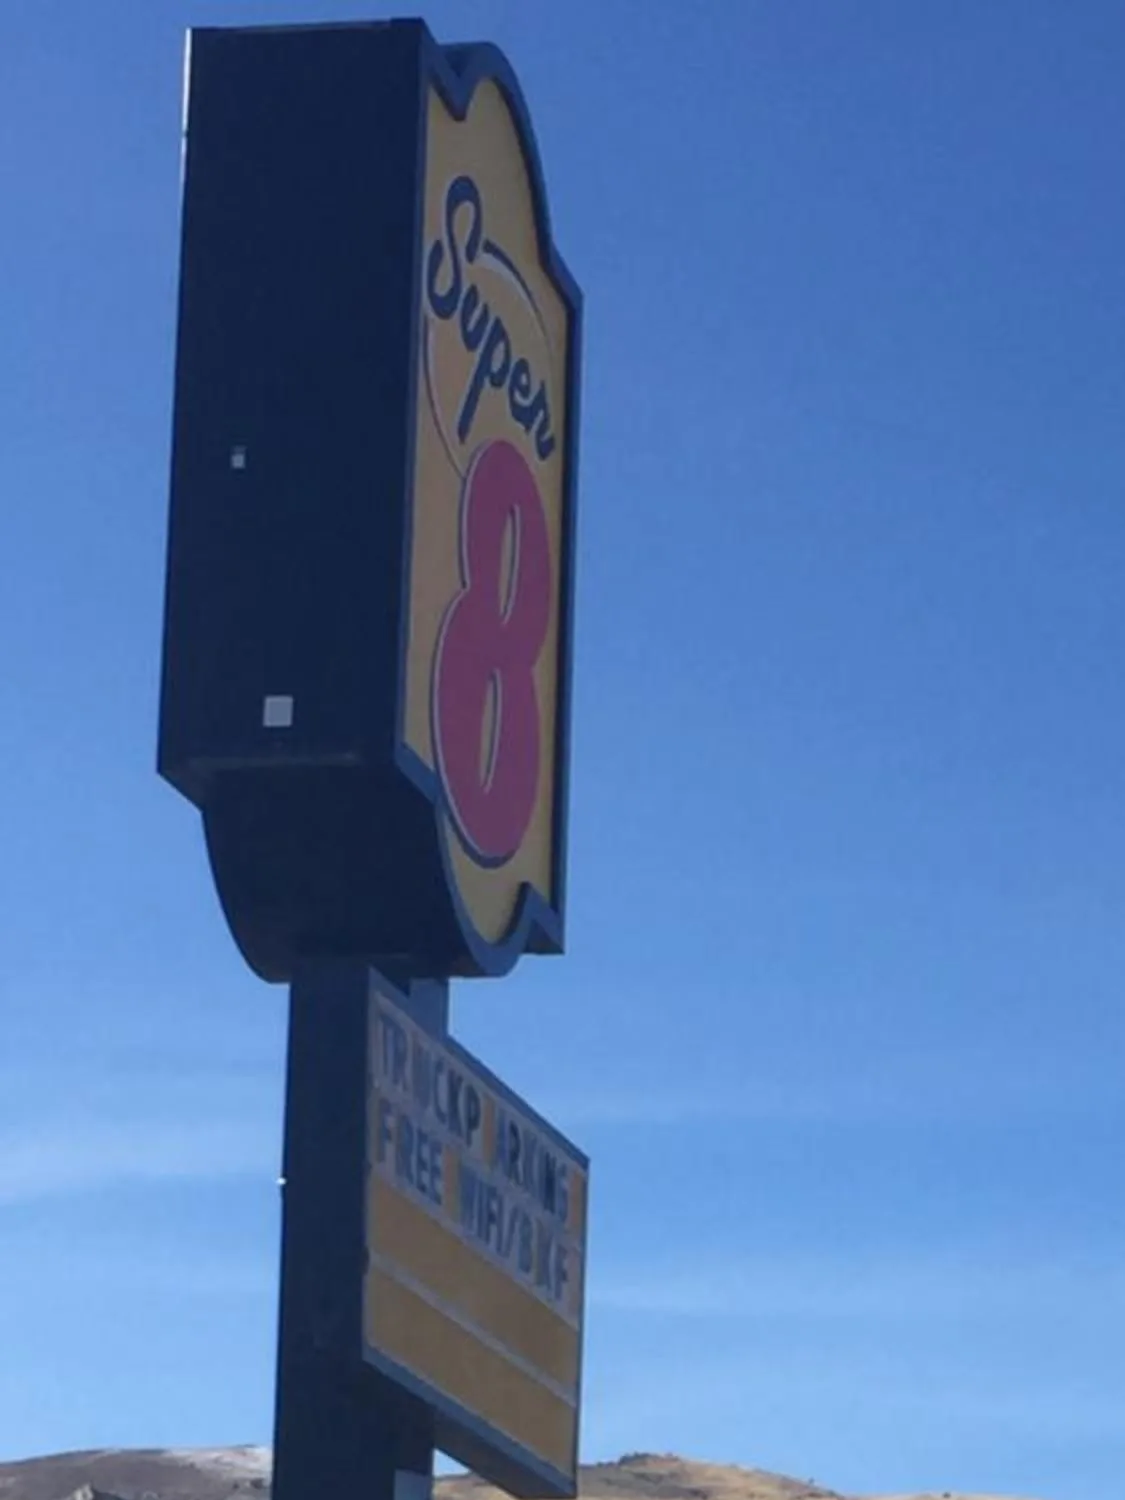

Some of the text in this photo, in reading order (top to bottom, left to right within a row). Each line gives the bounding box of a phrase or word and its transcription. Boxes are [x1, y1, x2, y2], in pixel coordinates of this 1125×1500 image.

[427, 174, 555, 461] Super
[431, 439, 551, 867] 8
[377, 1096, 443, 1206] FREE
